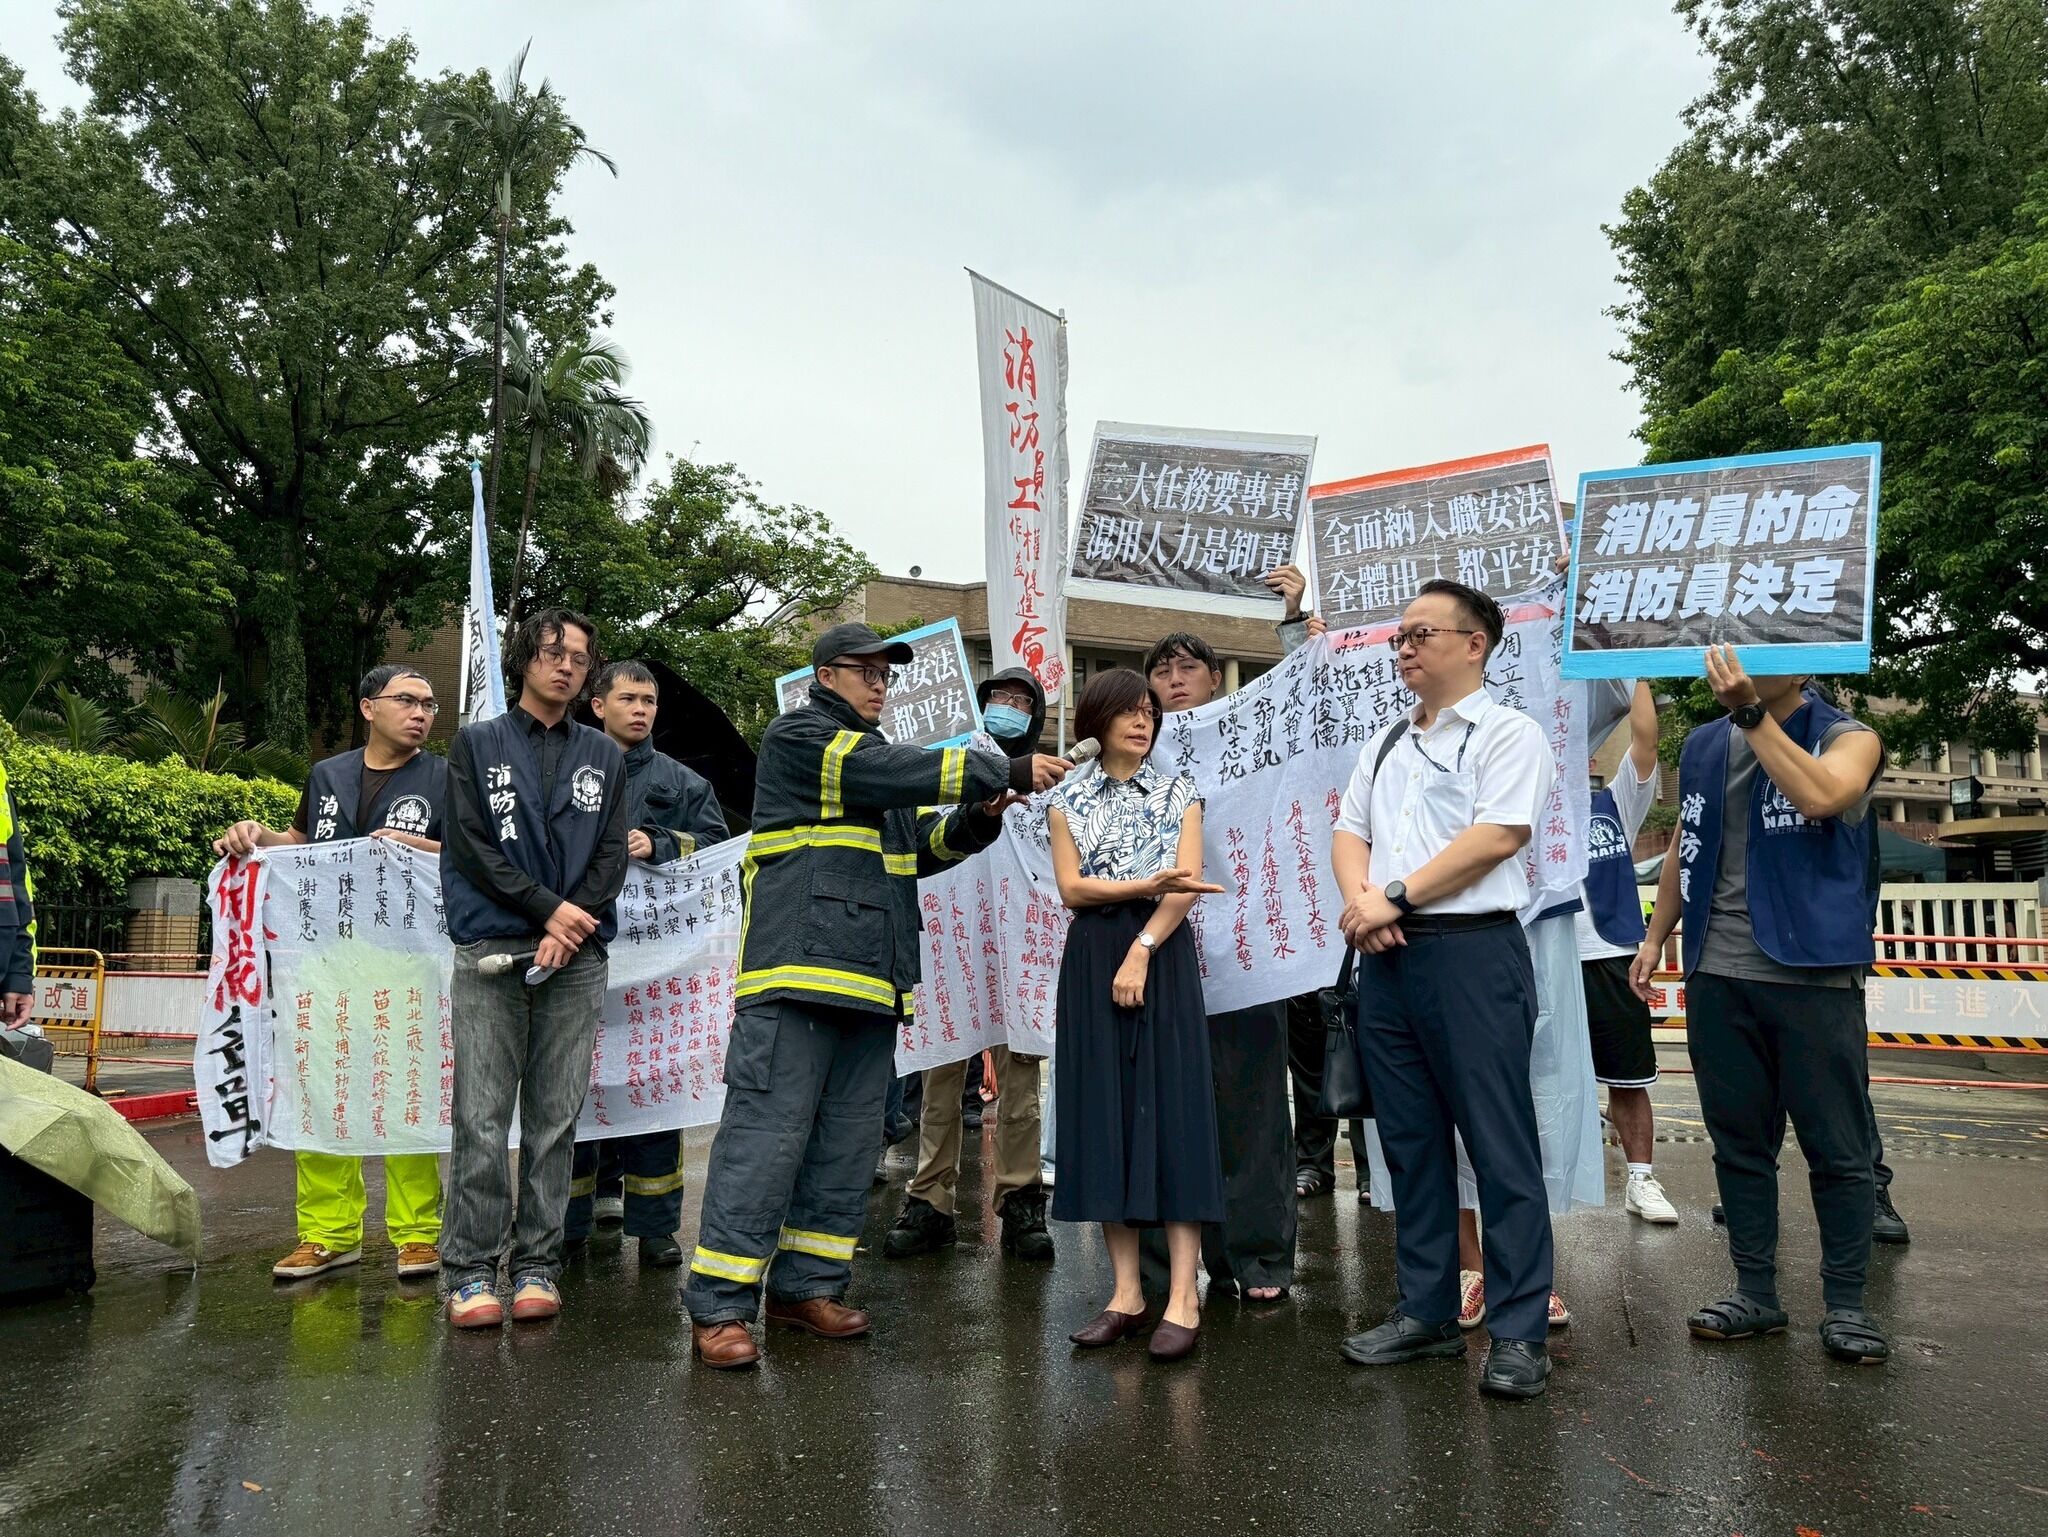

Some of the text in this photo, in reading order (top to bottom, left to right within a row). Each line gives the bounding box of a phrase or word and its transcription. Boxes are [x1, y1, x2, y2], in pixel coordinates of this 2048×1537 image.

[1096, 460, 1300, 522] 三大任務要專責
[1322, 482, 1551, 559] 全面納入職安法
[1594, 484, 1862, 557] 消防員的命
[1085, 515, 1290, 584] 混用人力是卸責
[1578, 556, 1846, 625] 消防員決定
[315, 795, 339, 840] 消防
[486, 763, 519, 842] 消防員
[1679, 792, 1706, 903] 消防員
[297, 878, 318, 942] 謝慶忠
[338, 871, 359, 940] 陳慶財
[624, 882, 644, 946] 陶廷舟
[643, 876, 662, 941] 黃尚強
[664, 877, 681, 937] 莊政潔
[33, 985, 89, 1011] 改道
[1865, 982, 2042, 1019] 禁止進入
[624, 986, 652, 1108] 搶救高雄氣爆
[646, 980, 669, 1104] 搶救高雄氣爆
[666, 976, 686, 1095] 搶救高雄氣爆
